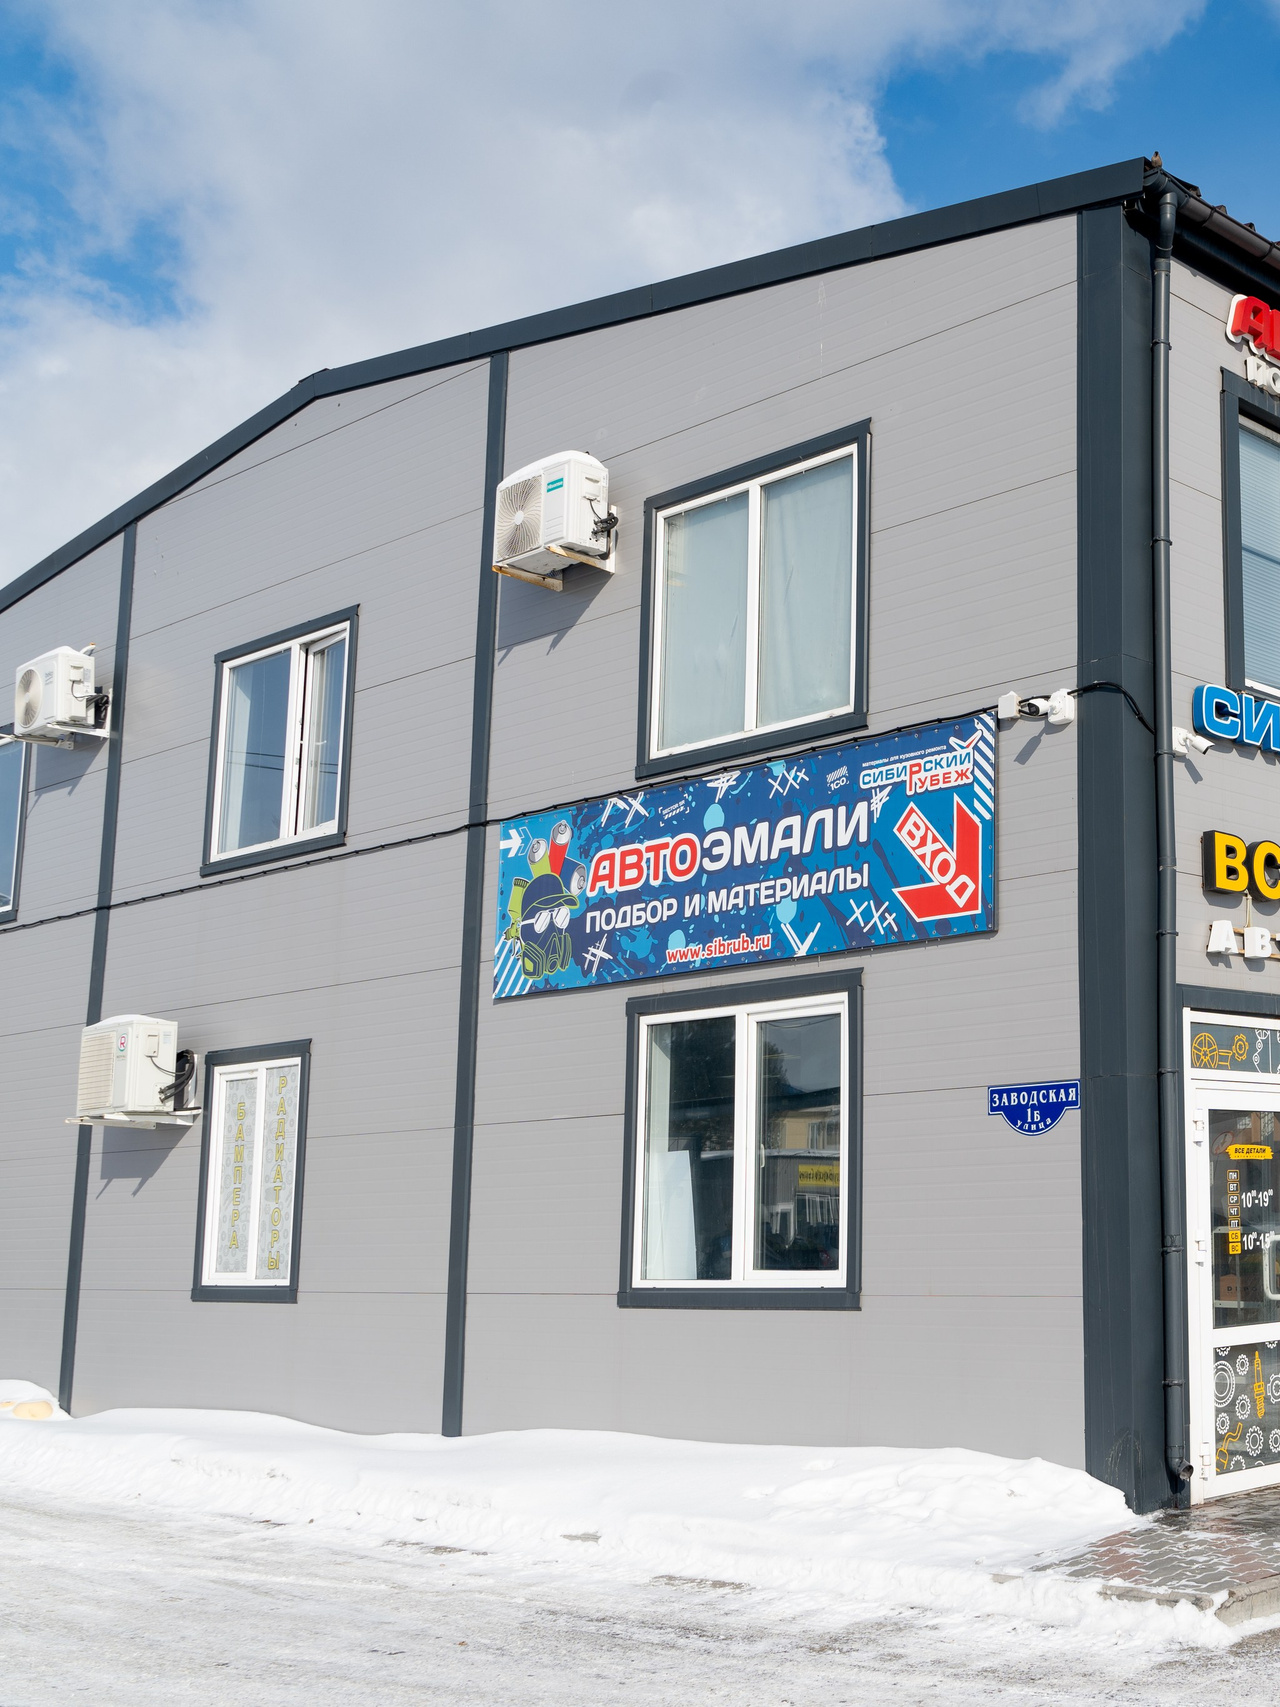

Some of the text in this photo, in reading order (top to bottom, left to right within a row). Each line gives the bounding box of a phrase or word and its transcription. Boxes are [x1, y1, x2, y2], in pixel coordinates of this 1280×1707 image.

[587, 800, 869, 898] АВТОЭМАЛИ
[902, 811, 975, 908] ВХОД
[585, 863, 869, 934] ПОДБОР И МАТЕРИАЛЫ
[666, 934, 772, 965] www.sibrub.ru
[992, 1087, 1077, 1107] ЗАВОДСКАЯ
[1016, 1117, 1052, 1131] улица
[229, 1102, 246, 1249] БАМПЕРА
[267, 1076, 288, 1270] РАДИАТОРЫ
